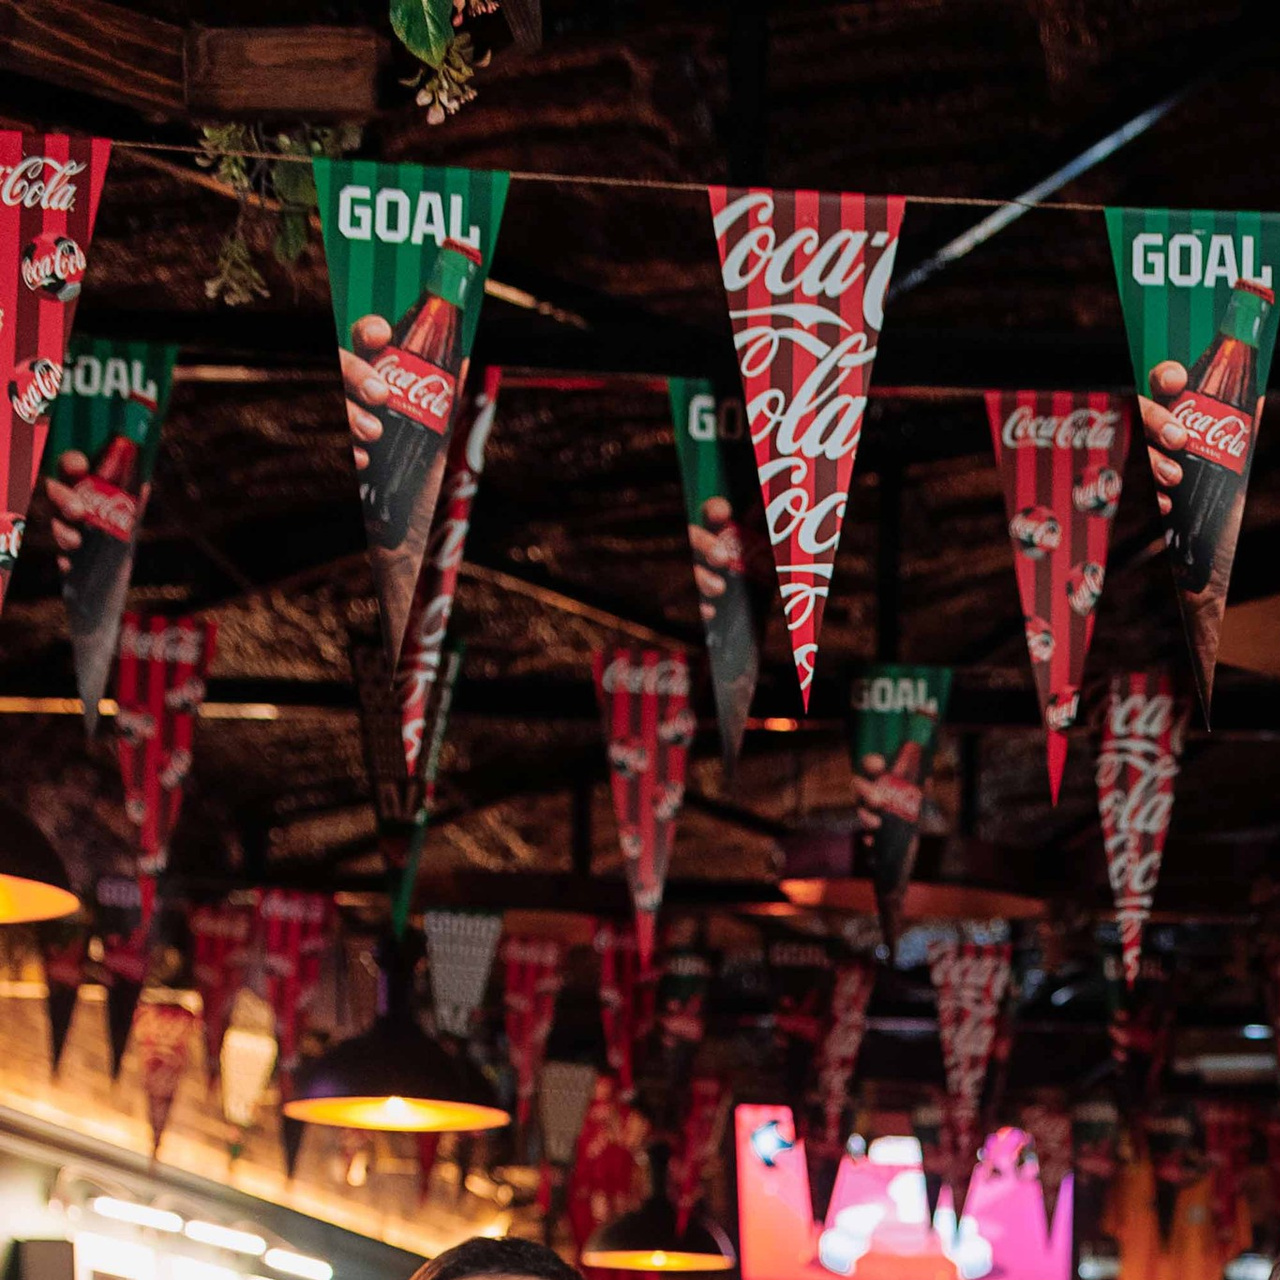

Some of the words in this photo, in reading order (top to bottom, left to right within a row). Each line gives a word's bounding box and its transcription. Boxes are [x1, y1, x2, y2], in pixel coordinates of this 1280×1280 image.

[338, 184, 481, 250] GOAL
[1132, 233, 1273, 289] GOAL
[1003, 405, 1121, 449] Coca-Cola
[1172, 399, 1247, 458] Coca-Cola
